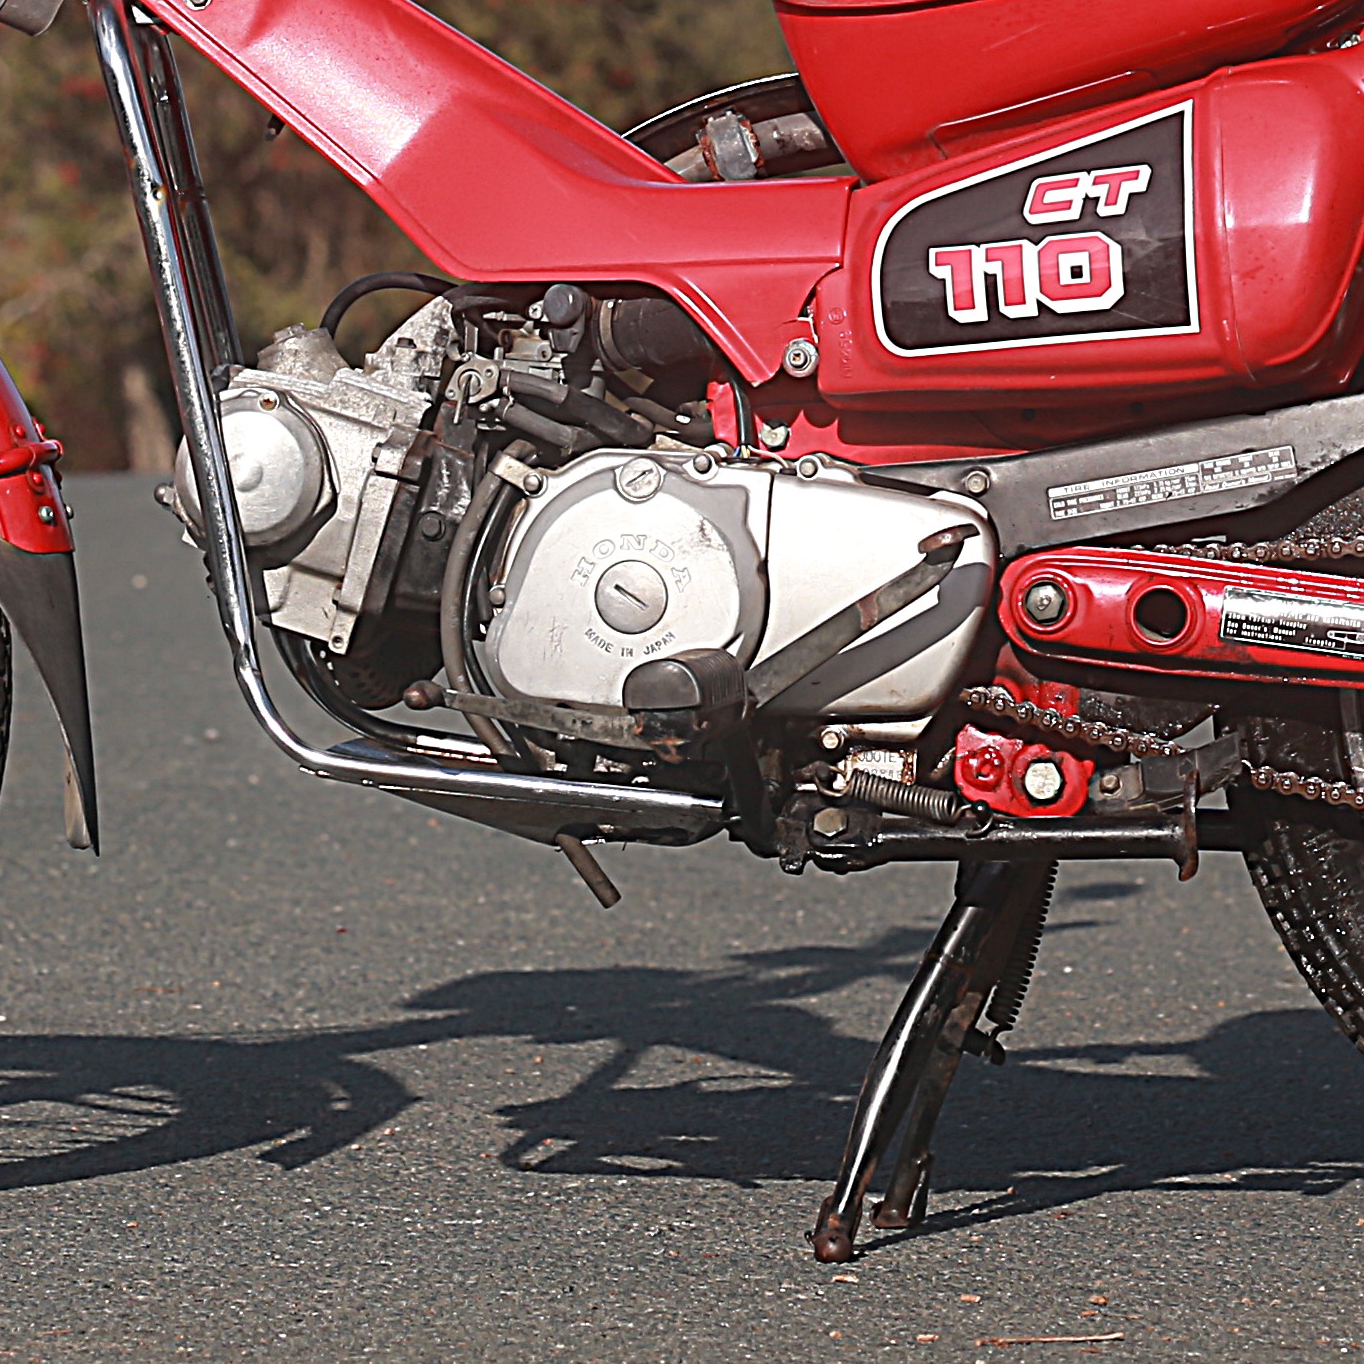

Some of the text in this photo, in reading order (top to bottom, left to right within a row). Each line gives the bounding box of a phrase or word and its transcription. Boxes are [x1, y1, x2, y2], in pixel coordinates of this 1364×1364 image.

[1023, 164, 1152, 224] CT
[929, 231, 1124, 323] 110
[1101, 467, 1185, 487] INFORMATION
[570, 534, 692, 593] HONDA
[584, 628, 677, 657] MADE IN JAPAN
